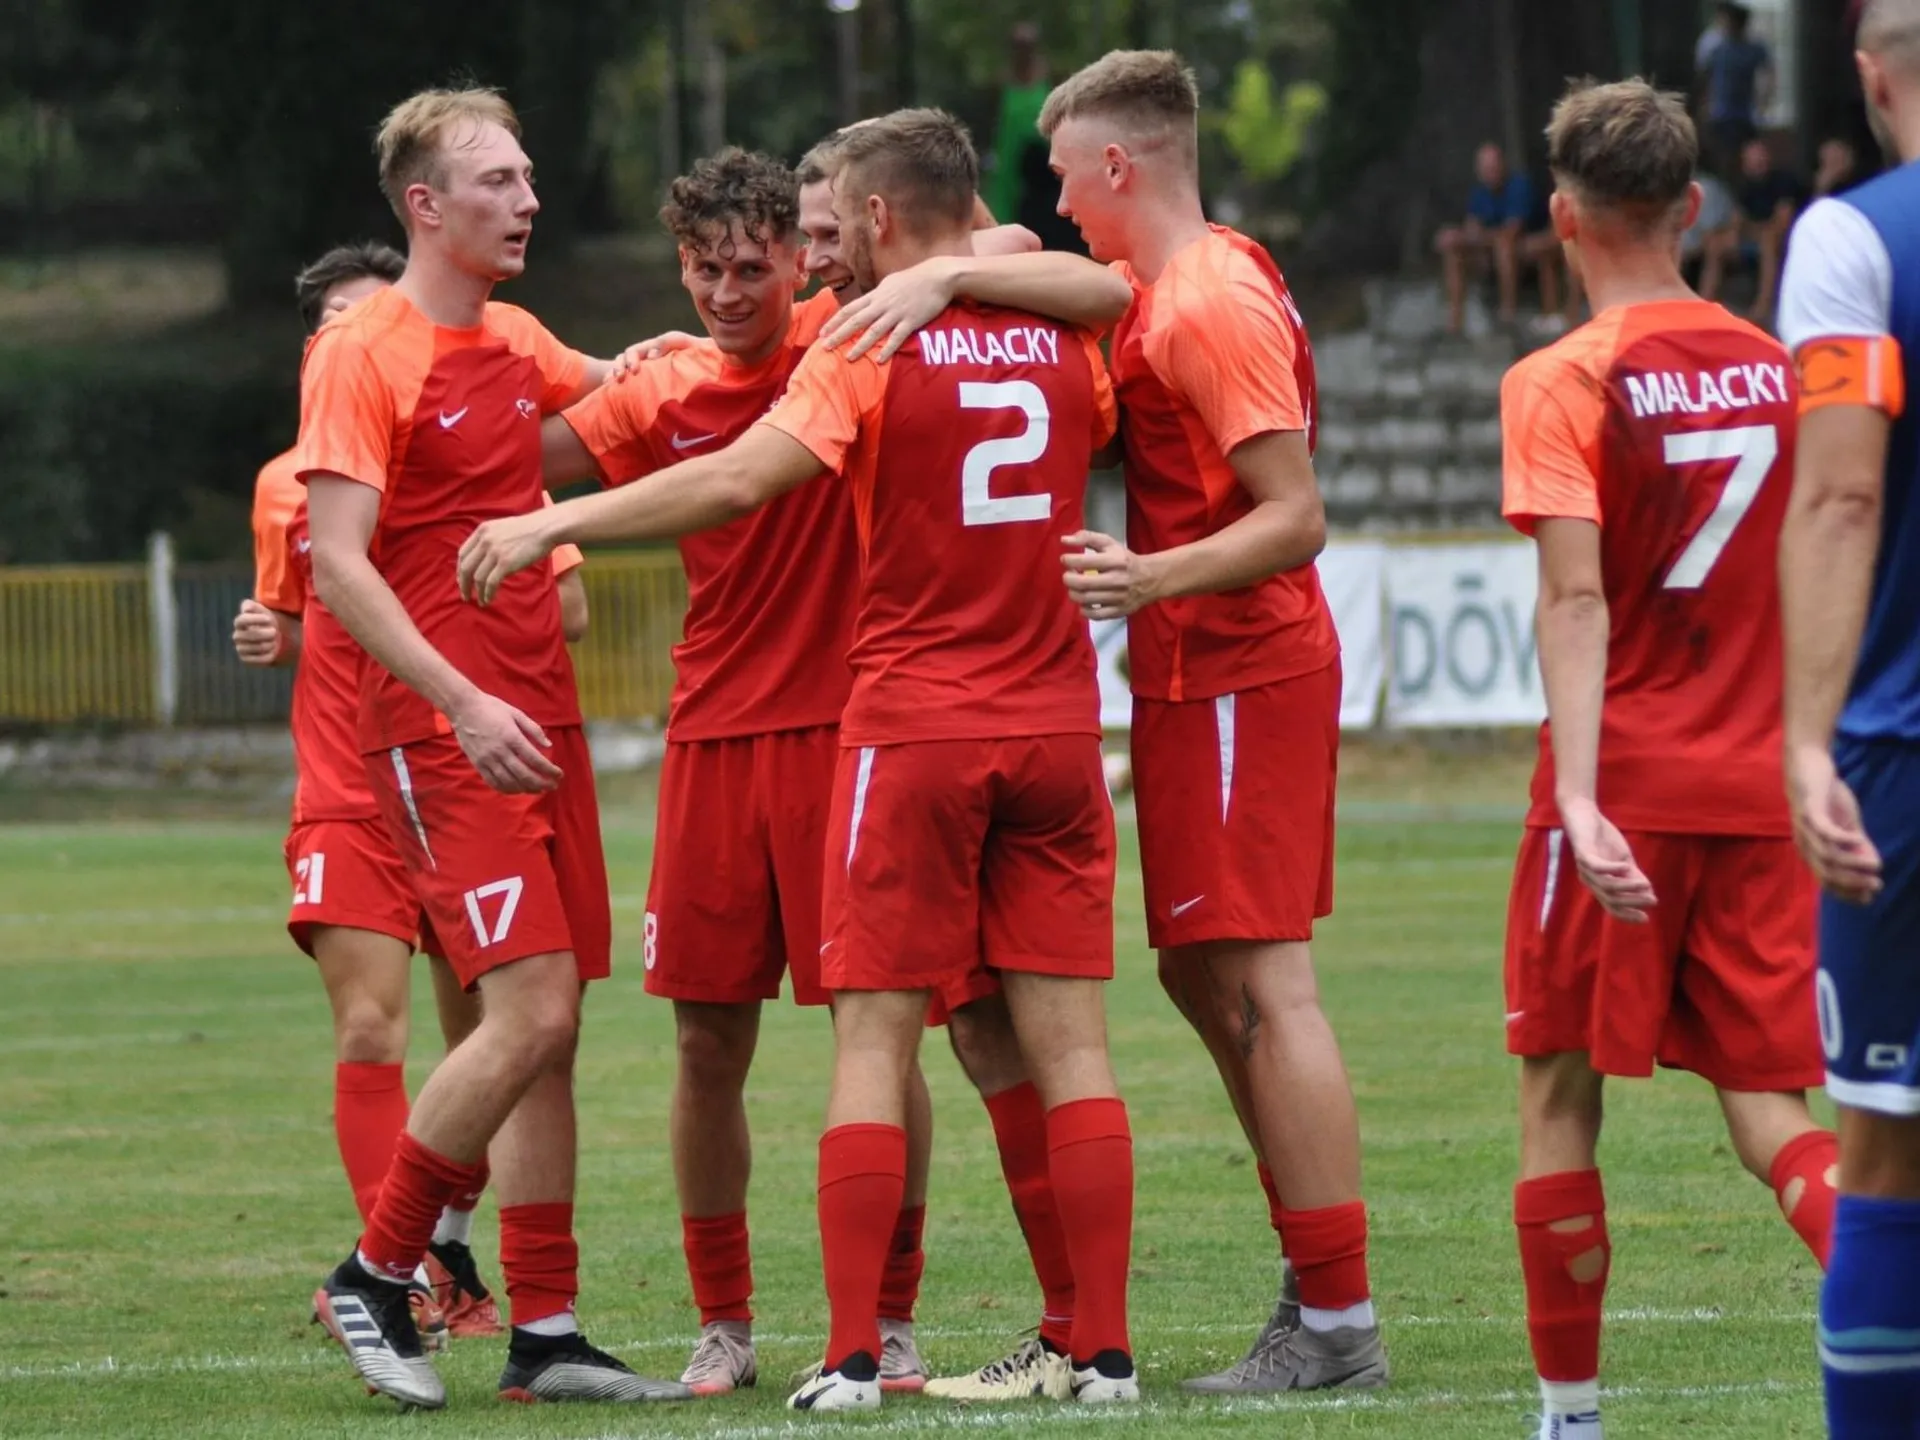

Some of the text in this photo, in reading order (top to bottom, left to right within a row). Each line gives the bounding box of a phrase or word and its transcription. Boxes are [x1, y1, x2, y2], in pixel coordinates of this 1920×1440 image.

[919, 328, 1058, 365] MALACKY
[1625, 362, 1789, 417] MALACKY
[959, 380, 1052, 526] 2
[1663, 424, 1778, 589] 7
[293, 852, 325, 904] 21
[464, 876, 524, 948] 17
